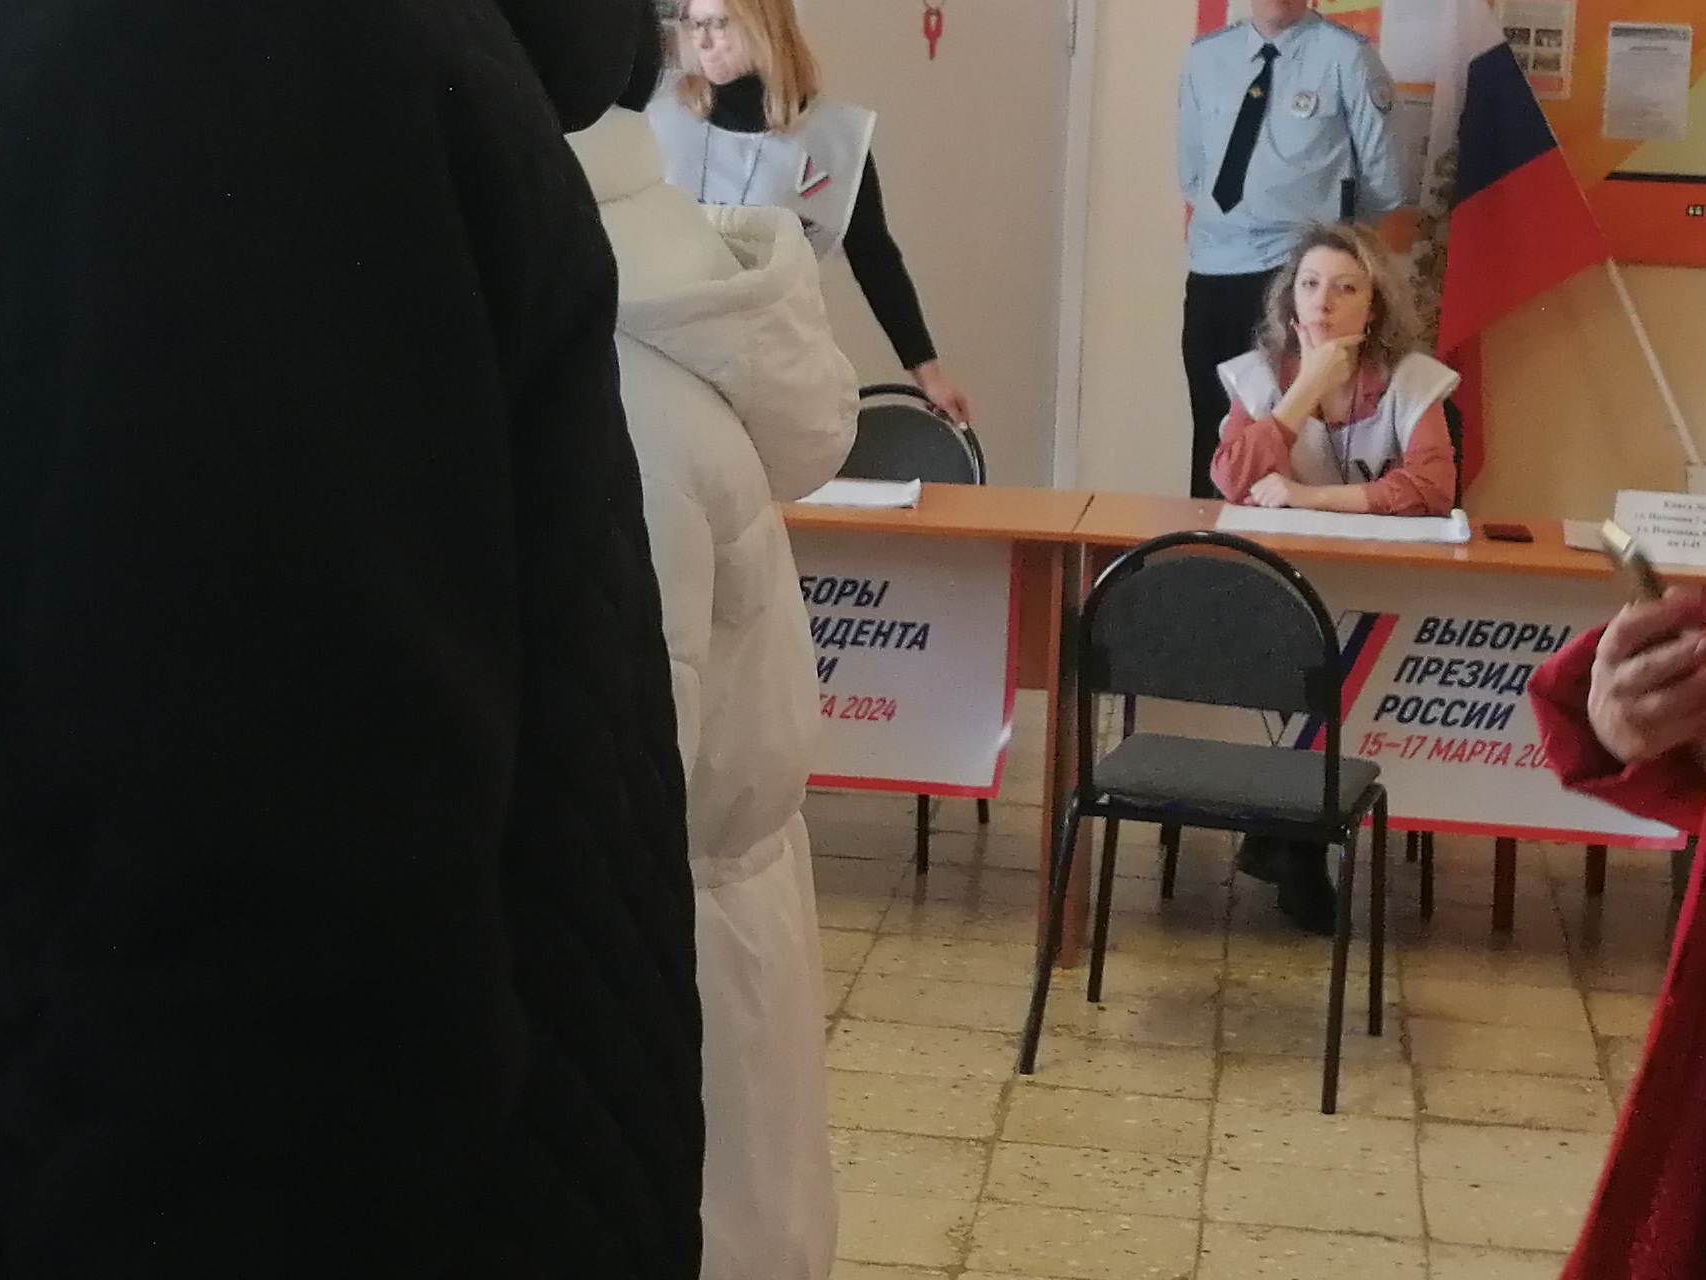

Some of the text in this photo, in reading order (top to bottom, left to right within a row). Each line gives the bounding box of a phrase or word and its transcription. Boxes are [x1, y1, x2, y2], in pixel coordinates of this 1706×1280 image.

[1414, 616, 1572, 654] ВЫБОРЫ
[1394, 654, 1535, 696] ПРЕЗИД
[839, 694, 898, 721] 2024
[1373, 694, 1516, 730] РОССИИ
[1427, 736, 1513, 767] МАРТА
